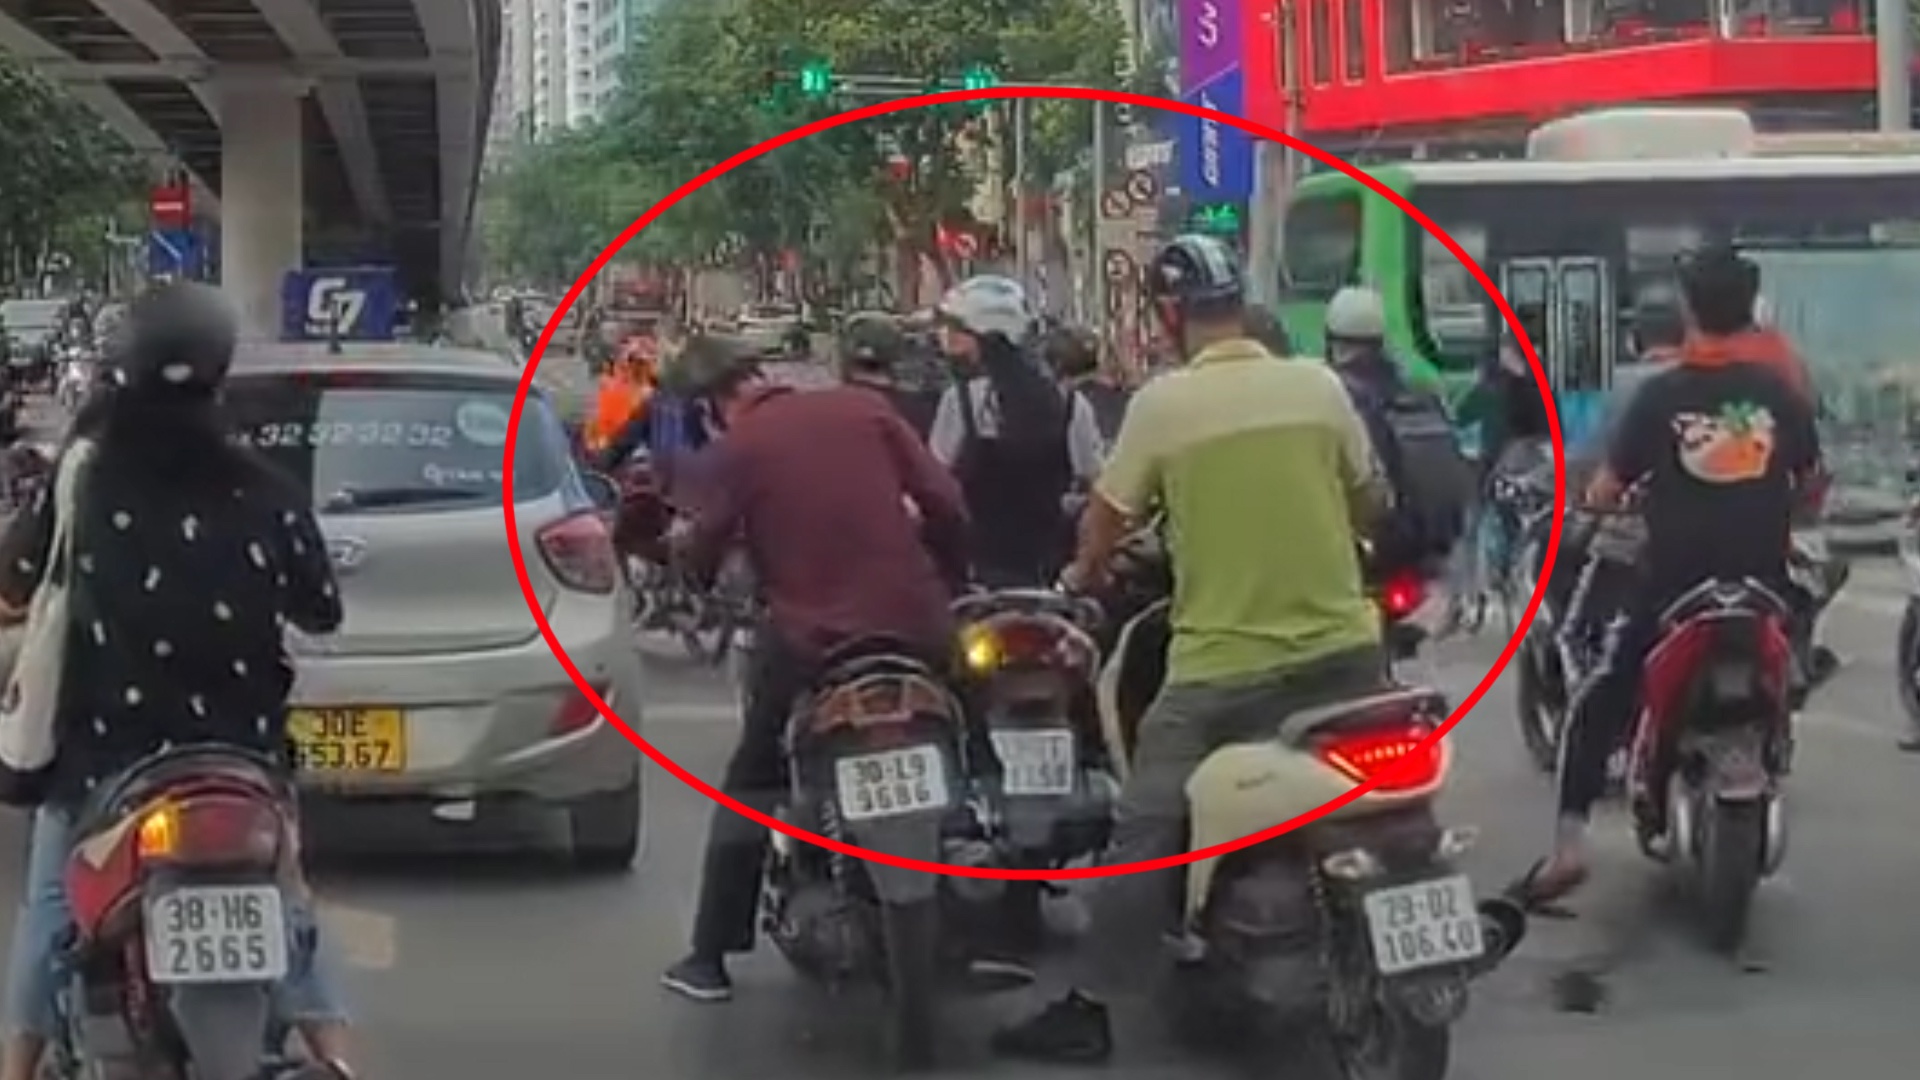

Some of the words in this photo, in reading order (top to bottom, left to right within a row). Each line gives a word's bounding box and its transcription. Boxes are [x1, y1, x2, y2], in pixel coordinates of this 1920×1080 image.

[257, 422, 302, 447] 32
[308, 422, 353, 447] 32
[357, 422, 402, 447] 32
[407, 423, 451, 447] 32
[311, 709, 368, 738] 30E
[169, 934, 266, 974] 2665
